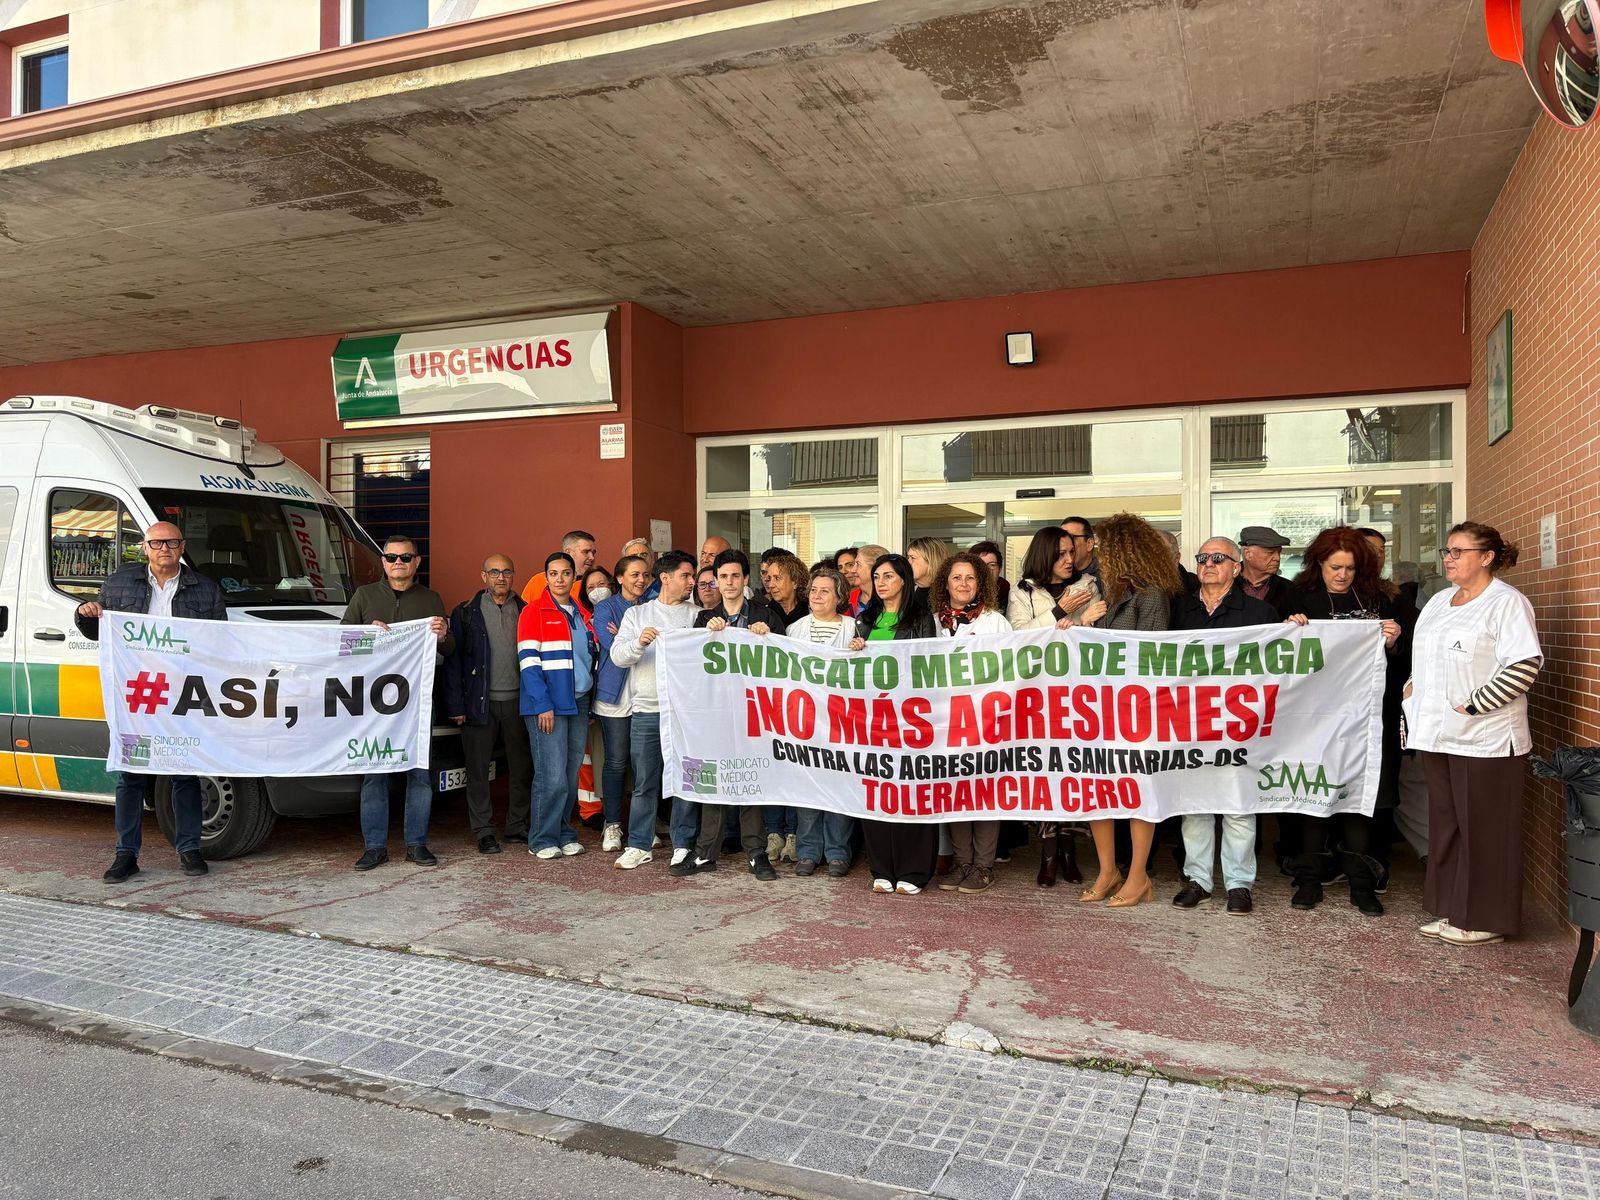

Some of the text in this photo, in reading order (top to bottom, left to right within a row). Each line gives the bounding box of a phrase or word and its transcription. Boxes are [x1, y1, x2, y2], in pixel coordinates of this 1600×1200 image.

[408, 340, 572, 379] URGENCIAS
[341, 392, 357, 400] Junta
[365, 387, 393, 398] Andalucía
[702, 638, 1325, 690] SINDICATO MÉDICO DE MÁLAGA
[125, 669, 410, 729] #ASÍ, NO
[745, 684, 1280, 749] ¡NO MÁS AGRESIONES!
[153, 735, 200, 747] SINDICATO
[347, 736, 406, 761] SMA
[719, 757, 771, 770] SINDICATO
[772, 738, 1248, 780] CONTRA LAS AGRESIONES A SANITARIAS-OS
[447, 769, 468, 788] 532
[720, 770, 759, 783] MÉDICO
[1257, 760, 1346, 797] SMA
[721, 783, 762, 796] MÁLAGA
[861, 776, 1142, 816] TOLERANCIA CERO
[1259, 795, 1290, 803] Sindicato
[1292, 795, 1317, 805] Médico
